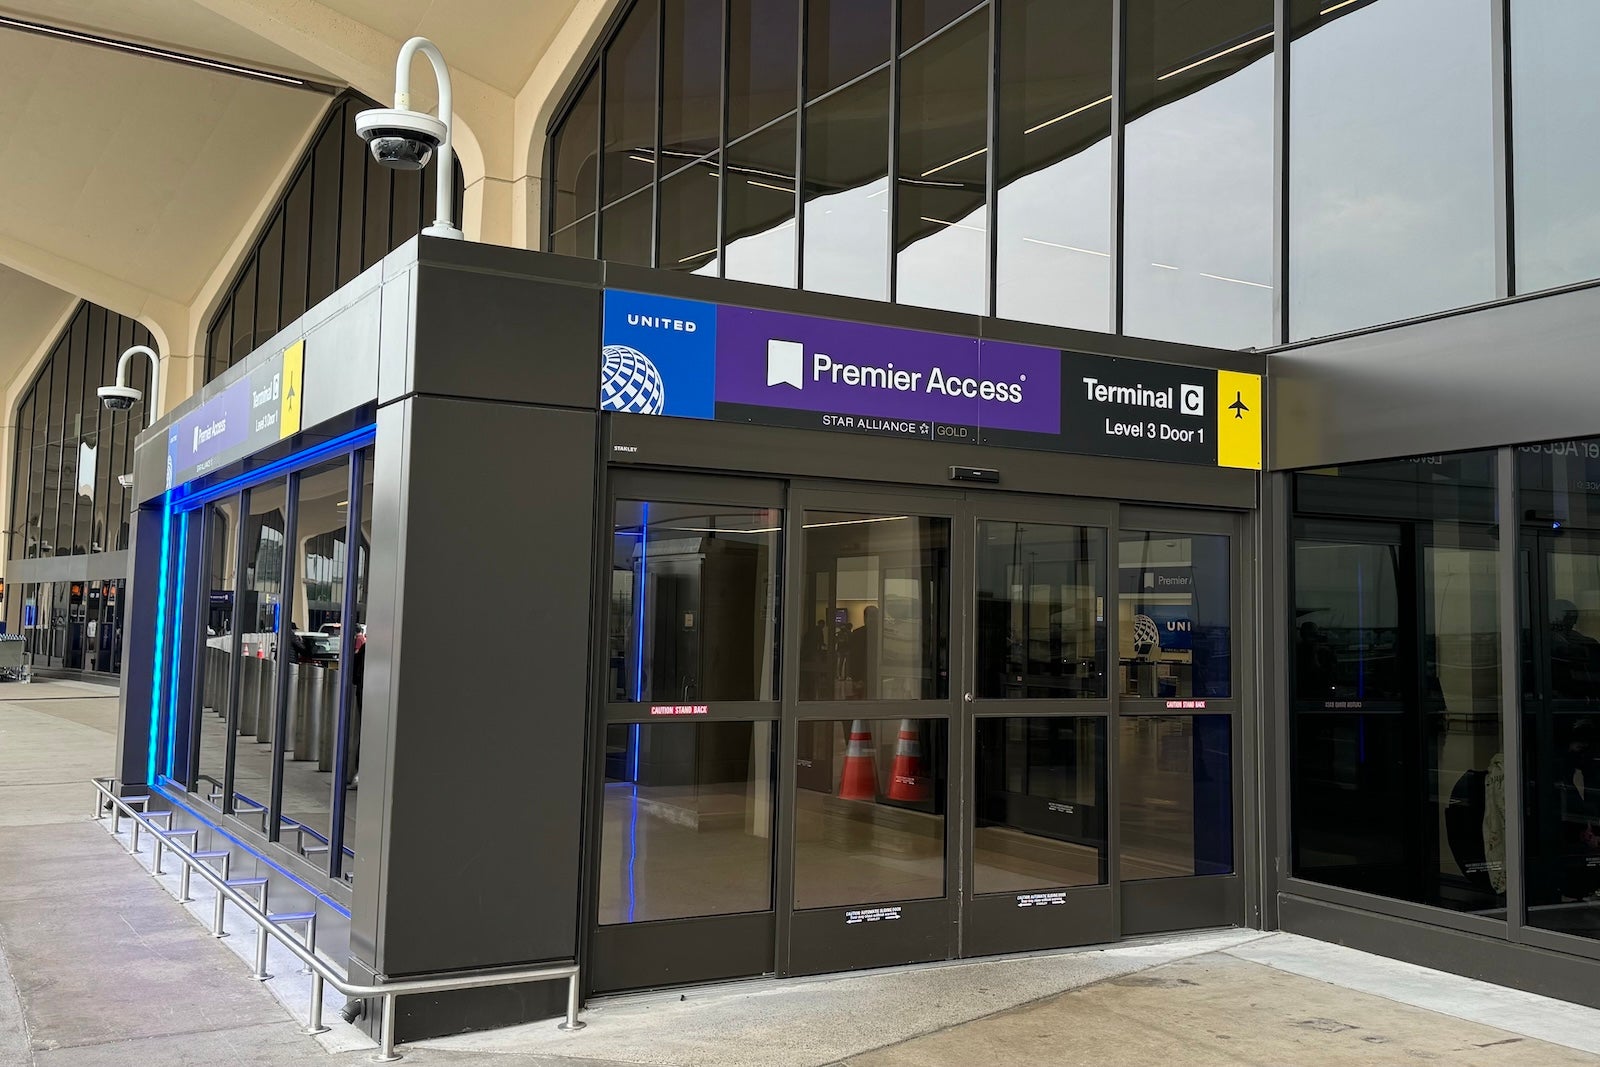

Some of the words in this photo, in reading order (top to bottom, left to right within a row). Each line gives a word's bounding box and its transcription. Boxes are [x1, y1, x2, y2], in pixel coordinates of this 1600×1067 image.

[627, 313, 697, 333] UNITED
[813, 352, 922, 394] Premier
[1083, 377, 1173, 409] Terminal
[822, 414, 854, 428] STAR
[857, 418, 916, 433] ALLIANCE
[936, 425, 968, 438] GOLD
[1105, 417, 1143, 438] Level
[1147, 423, 1156, 438] 3
[1160, 426, 1194, 443] Door
[1198, 428, 1204, 444] 1
[1158, 575, 1190, 586] Premier
[651, 706, 674, 715] CAUTION
[675, 706, 692, 714] STAND
[693, 705, 707, 713] BACK
